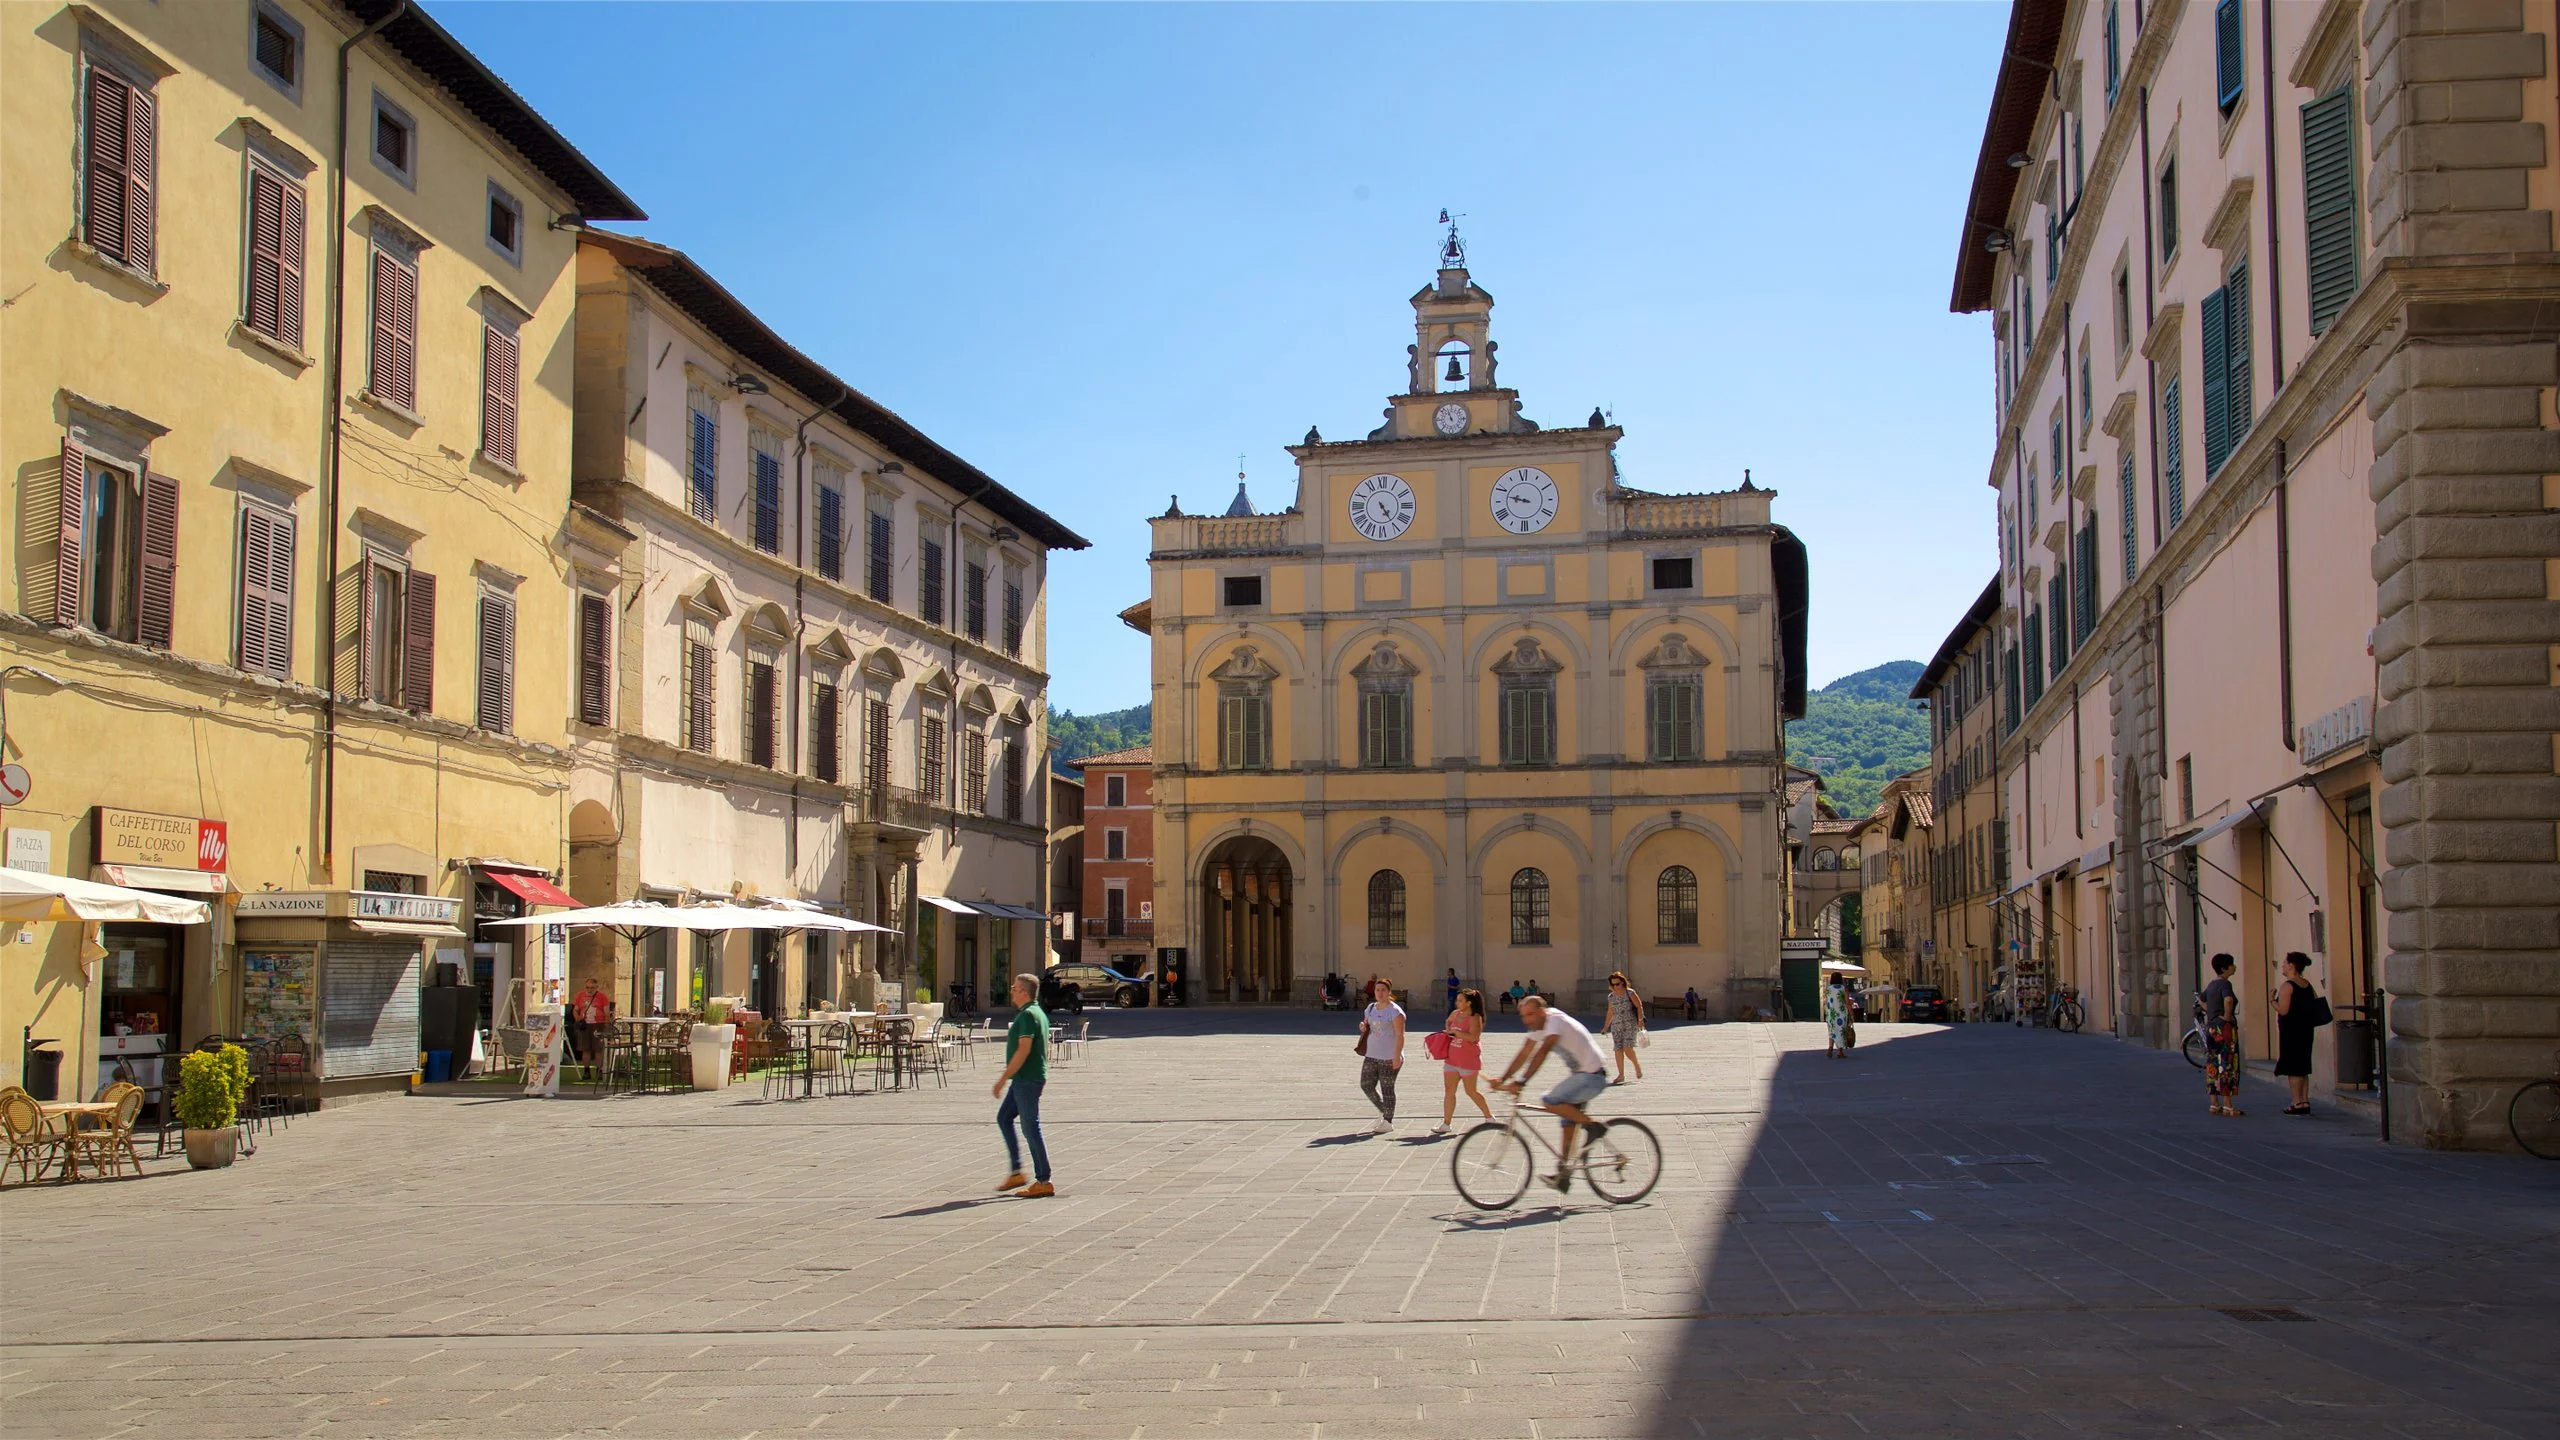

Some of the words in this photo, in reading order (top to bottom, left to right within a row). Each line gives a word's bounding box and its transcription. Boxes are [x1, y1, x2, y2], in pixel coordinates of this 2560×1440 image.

[1377, 476, 1388, 489] XII
[109, 813, 192, 835] CAFFETTERIA
[16, 837, 43, 851] PIAZZA
[117, 834, 142, 849] DEL
[145, 836, 186, 853] CORSO
[200, 828, 225, 868] illy
[251, 901, 267, 909] LA
[269, 900, 324, 910] NAZIONE
[364, 898, 378, 914] LA
[389, 900, 443, 918] NAZIONE
